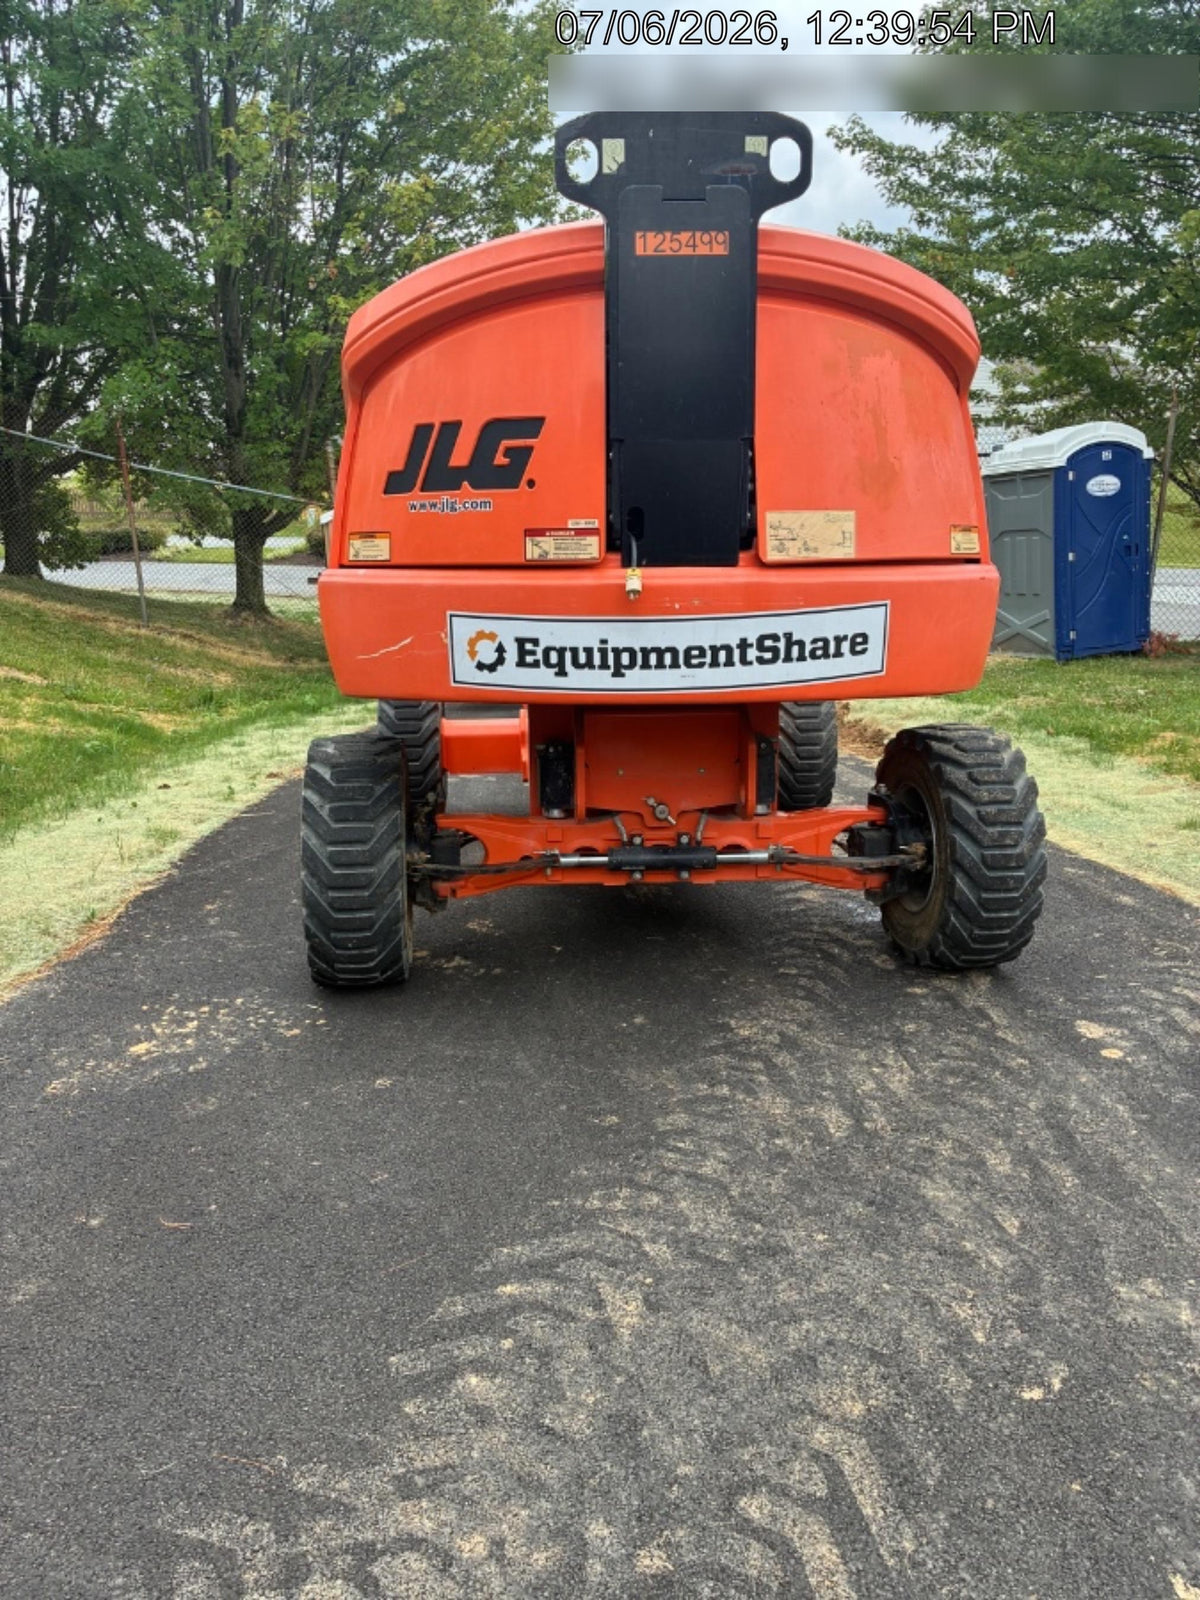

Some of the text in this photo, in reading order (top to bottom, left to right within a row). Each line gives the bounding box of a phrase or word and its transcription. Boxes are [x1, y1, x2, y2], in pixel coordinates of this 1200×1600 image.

[637, 232, 728, 253] 125499
[408, 497, 492, 513] www.jlg.com
[514, 631, 869, 678] EquipmentShare
